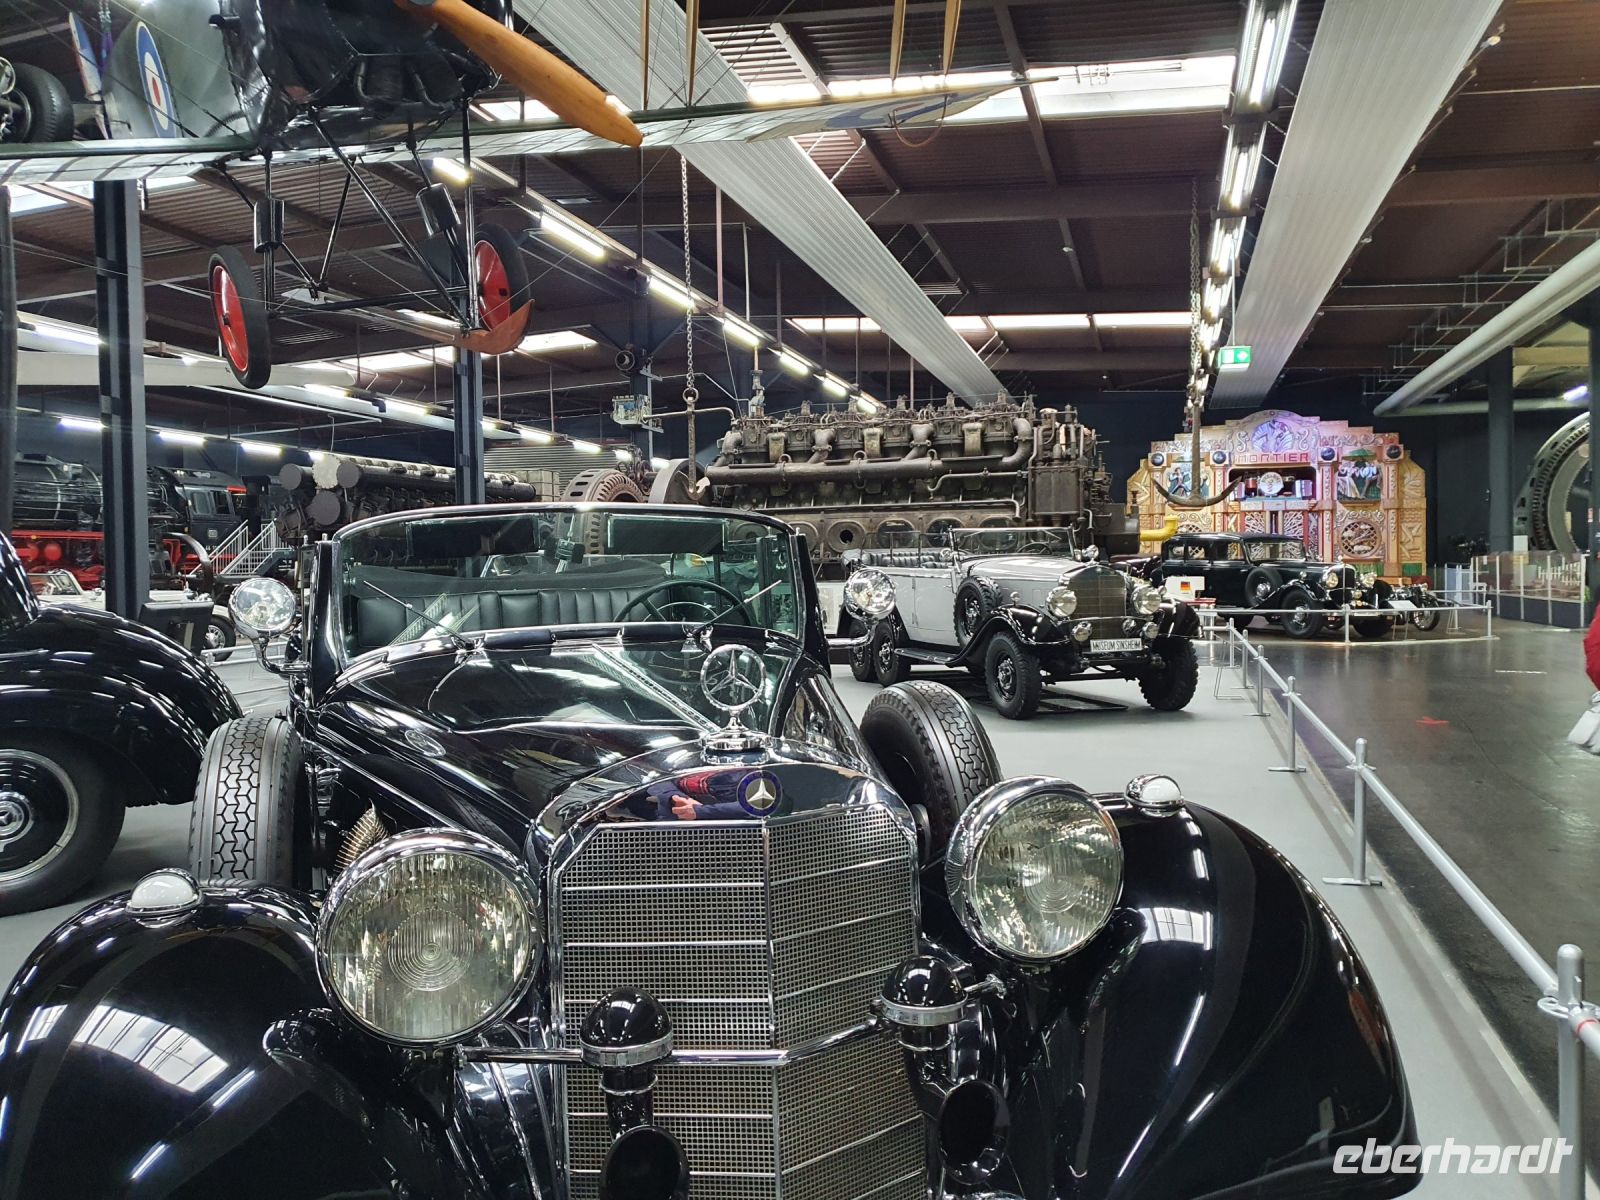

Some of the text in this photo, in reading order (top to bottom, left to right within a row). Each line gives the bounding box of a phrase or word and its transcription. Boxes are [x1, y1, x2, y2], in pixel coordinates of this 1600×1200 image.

[1234, 453, 1309, 463] MORTIER
[1092, 640, 1141, 651] MUSEUM SINSHEIM
